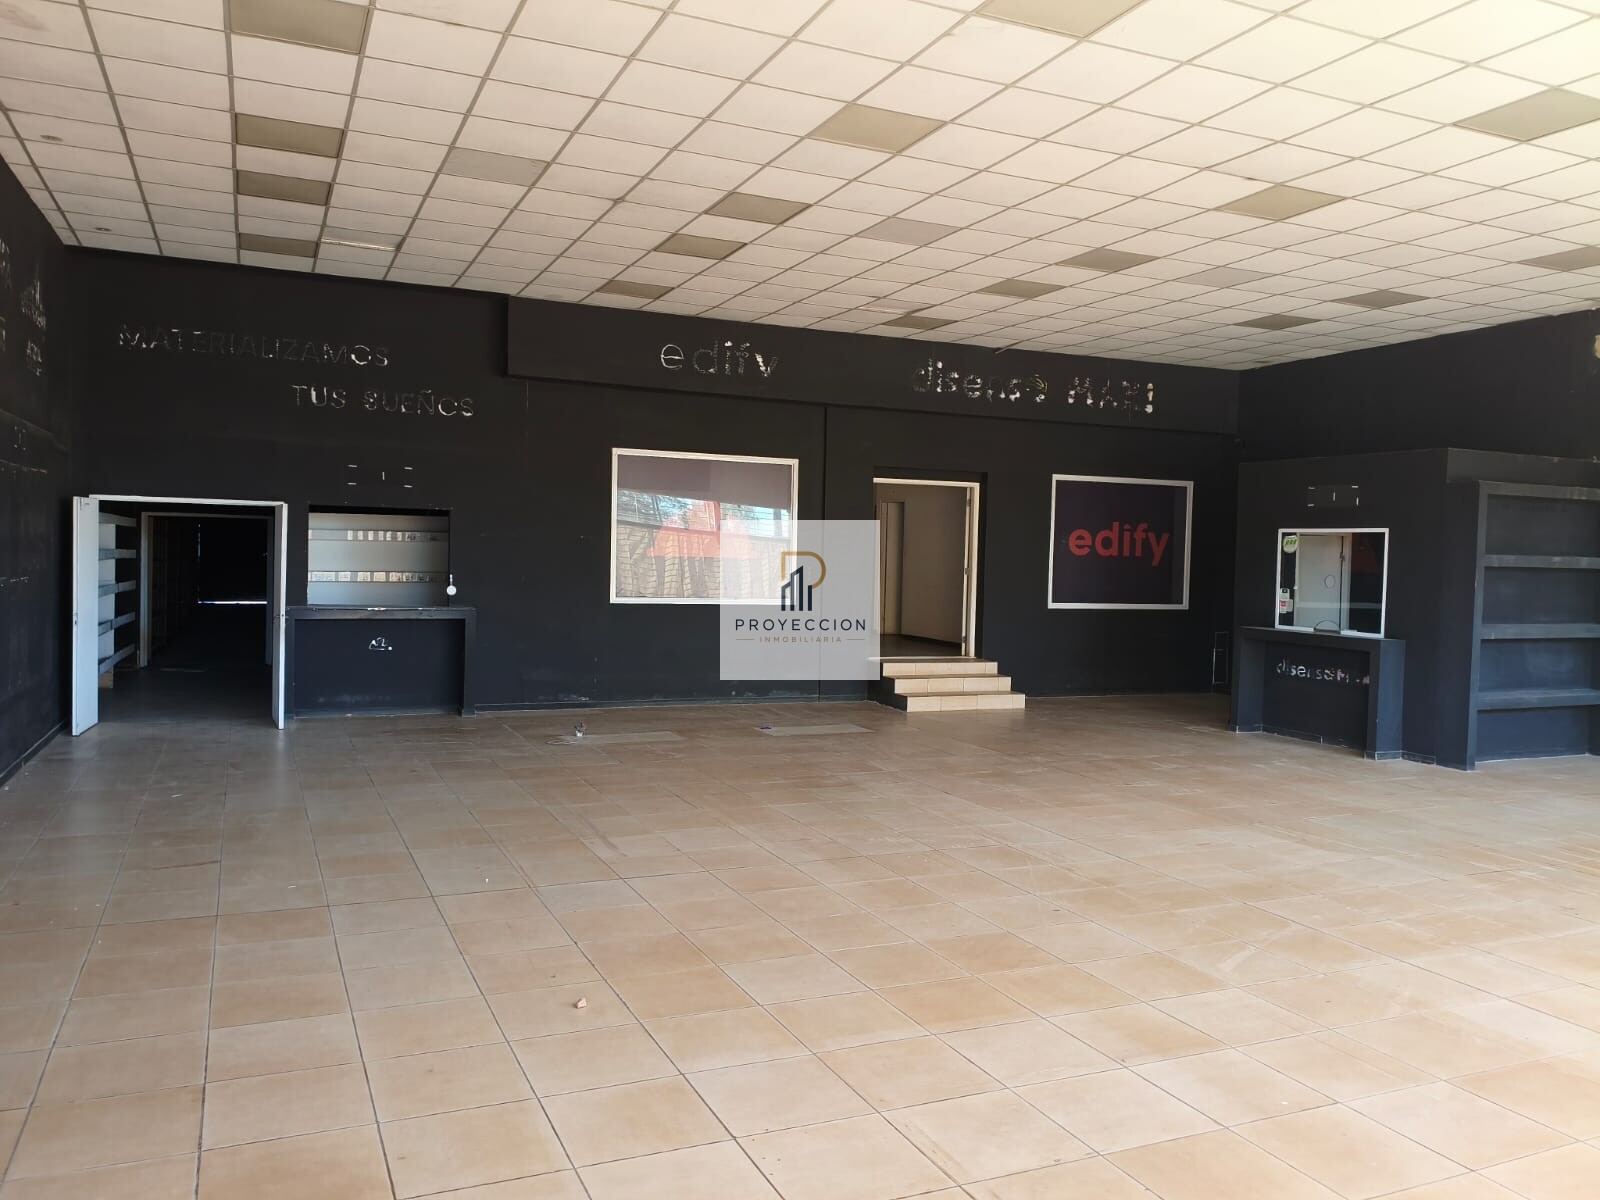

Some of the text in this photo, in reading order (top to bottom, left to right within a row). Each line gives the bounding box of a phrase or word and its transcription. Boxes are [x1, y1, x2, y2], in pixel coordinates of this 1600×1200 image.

[291, 384, 474, 417] TUS SUEÑOS
[1068, 521, 1170, 567] edify
